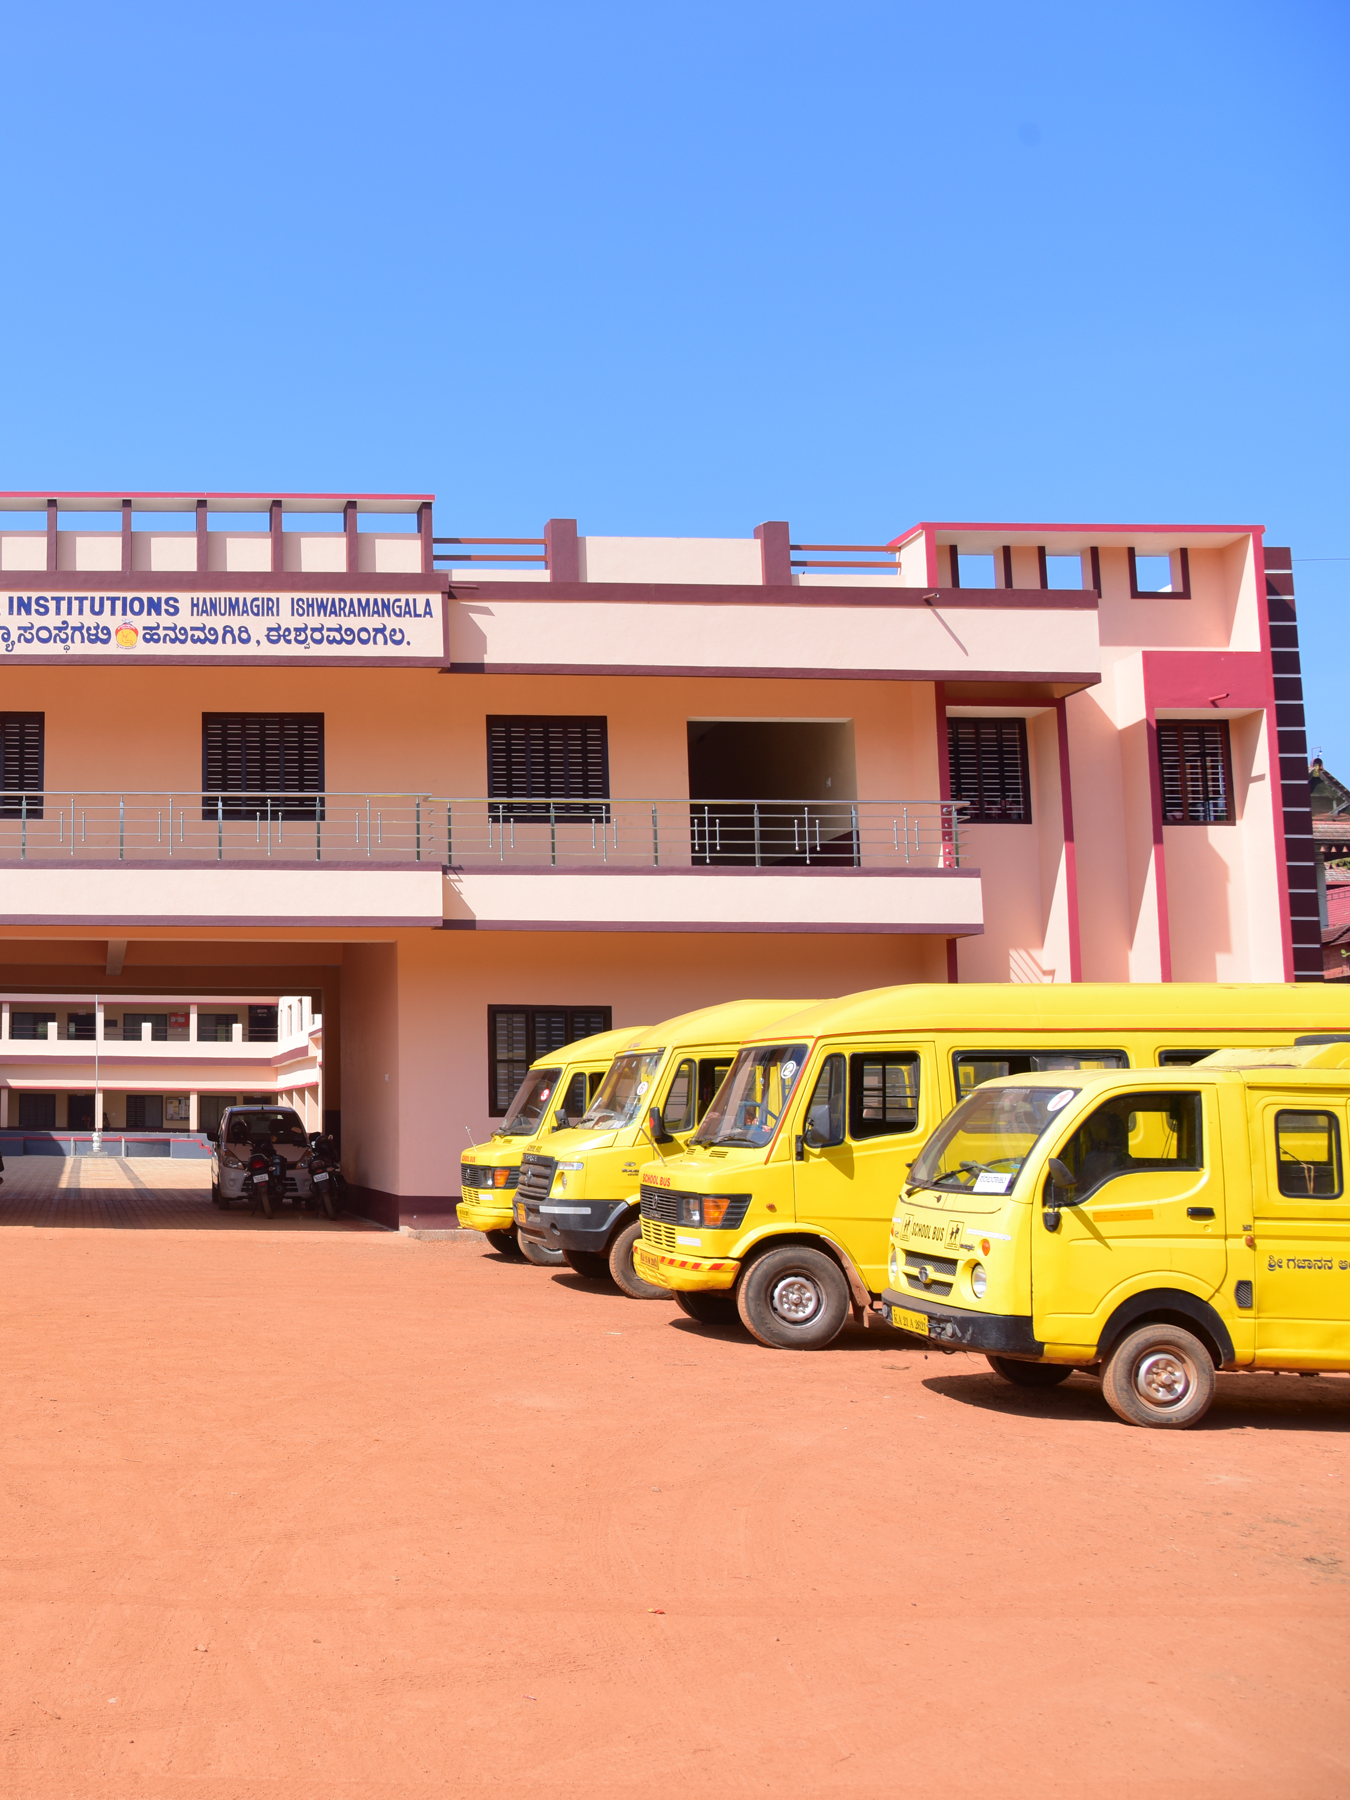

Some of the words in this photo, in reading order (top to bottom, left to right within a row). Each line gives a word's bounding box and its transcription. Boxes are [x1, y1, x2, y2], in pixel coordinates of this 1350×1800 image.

[8, 596, 180, 617] INSTITUTIONS
[190, 596, 280, 617] HANUMAGIRI
[290, 597, 434, 618] ISHWARAMANGALA
[784, 1063, 794, 1076] 2
[541, 1090, 549, 1099] 3
[638, 1083, 645, 1093] 6
[1052, 1092, 1071, 1109] 1
[642, 1173, 659, 1185] SCHOOL
[659, 1176, 671, 1187] BUS
[911, 1222, 931, 1240] SCHOOL
[932, 1226, 945, 1241] BUS
[1267, 1255, 1283, 1272] ಶ್ರೀ
[1286, 1255, 1334, 1270] ಗಜಾನನ
[894, 1314, 902, 1325] KA
